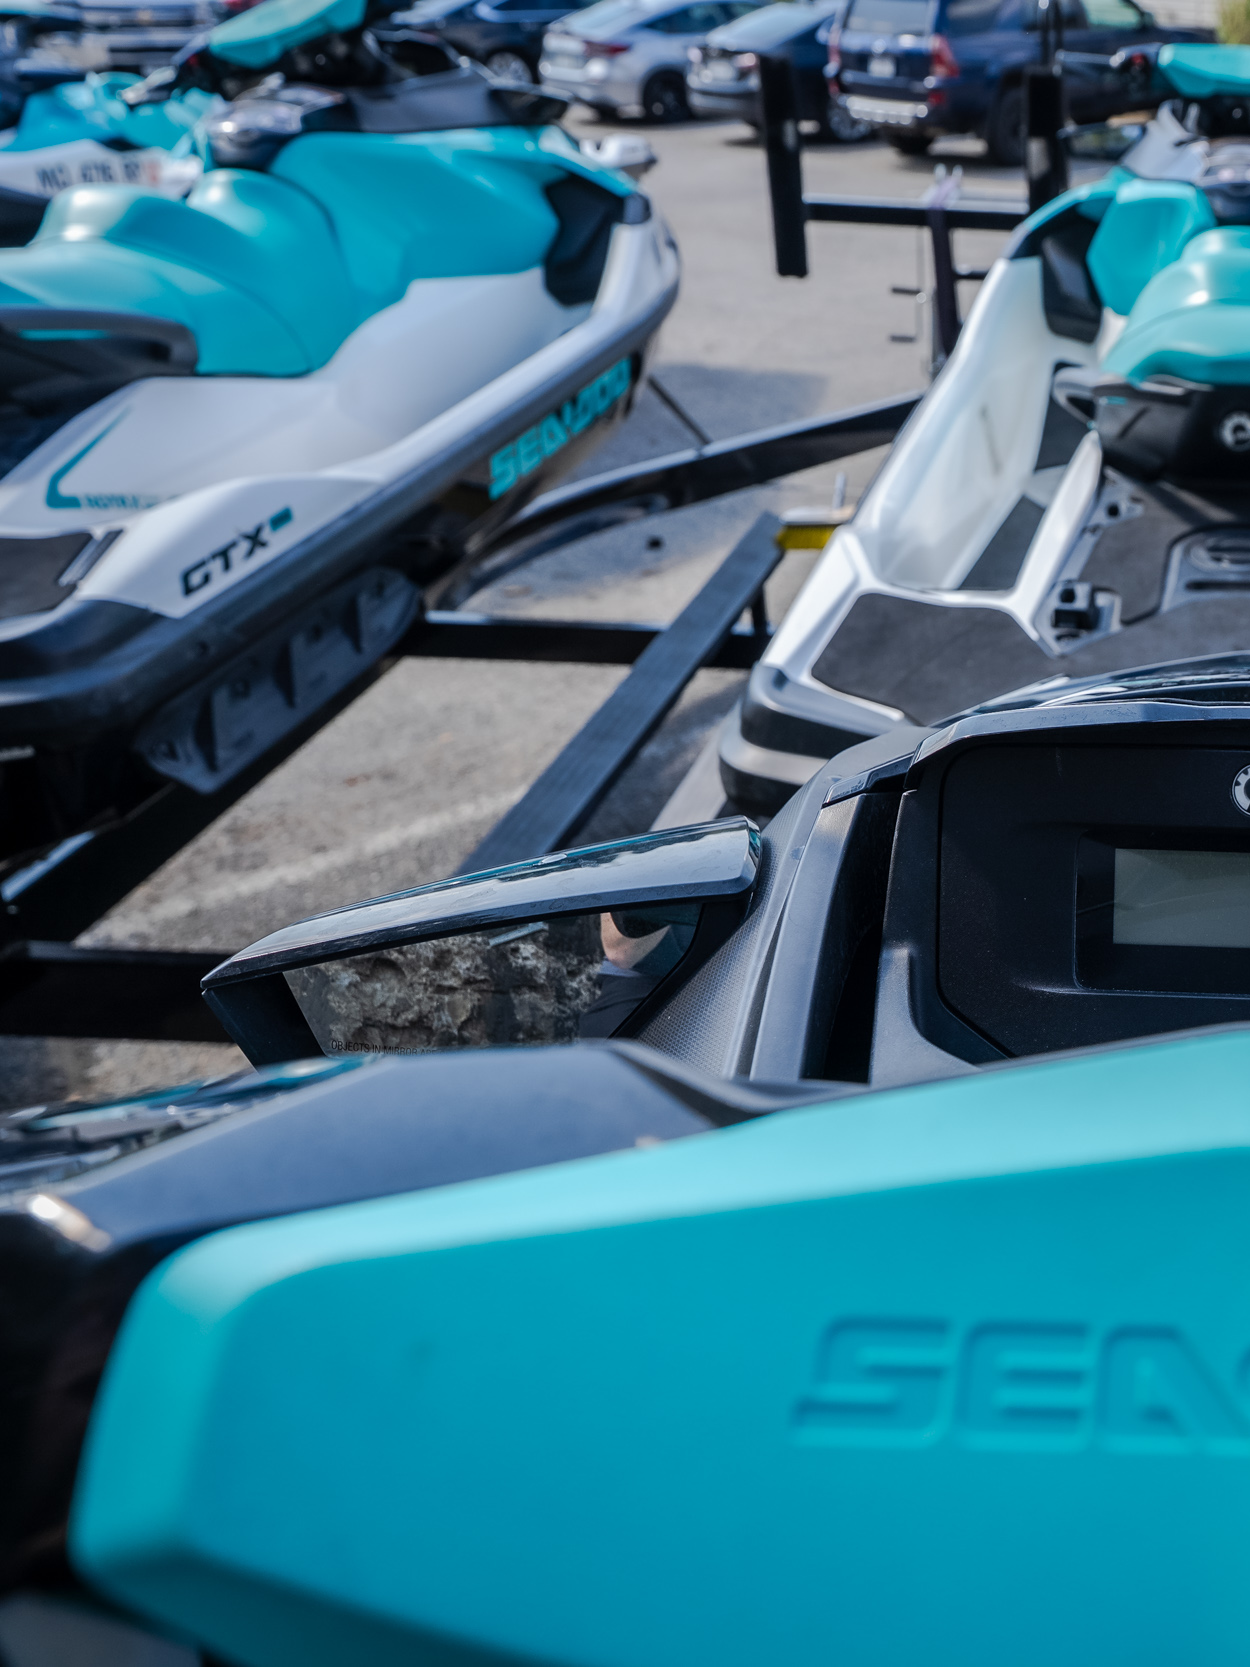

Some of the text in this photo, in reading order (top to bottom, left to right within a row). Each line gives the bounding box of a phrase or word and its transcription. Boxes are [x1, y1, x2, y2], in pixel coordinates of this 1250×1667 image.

[181, 523, 268, 597] GTX
[331, 1040, 370, 1053] OBJECTS
[372, 1045, 381, 1054] IN
[383, 1046, 418, 1056] MIRROR
